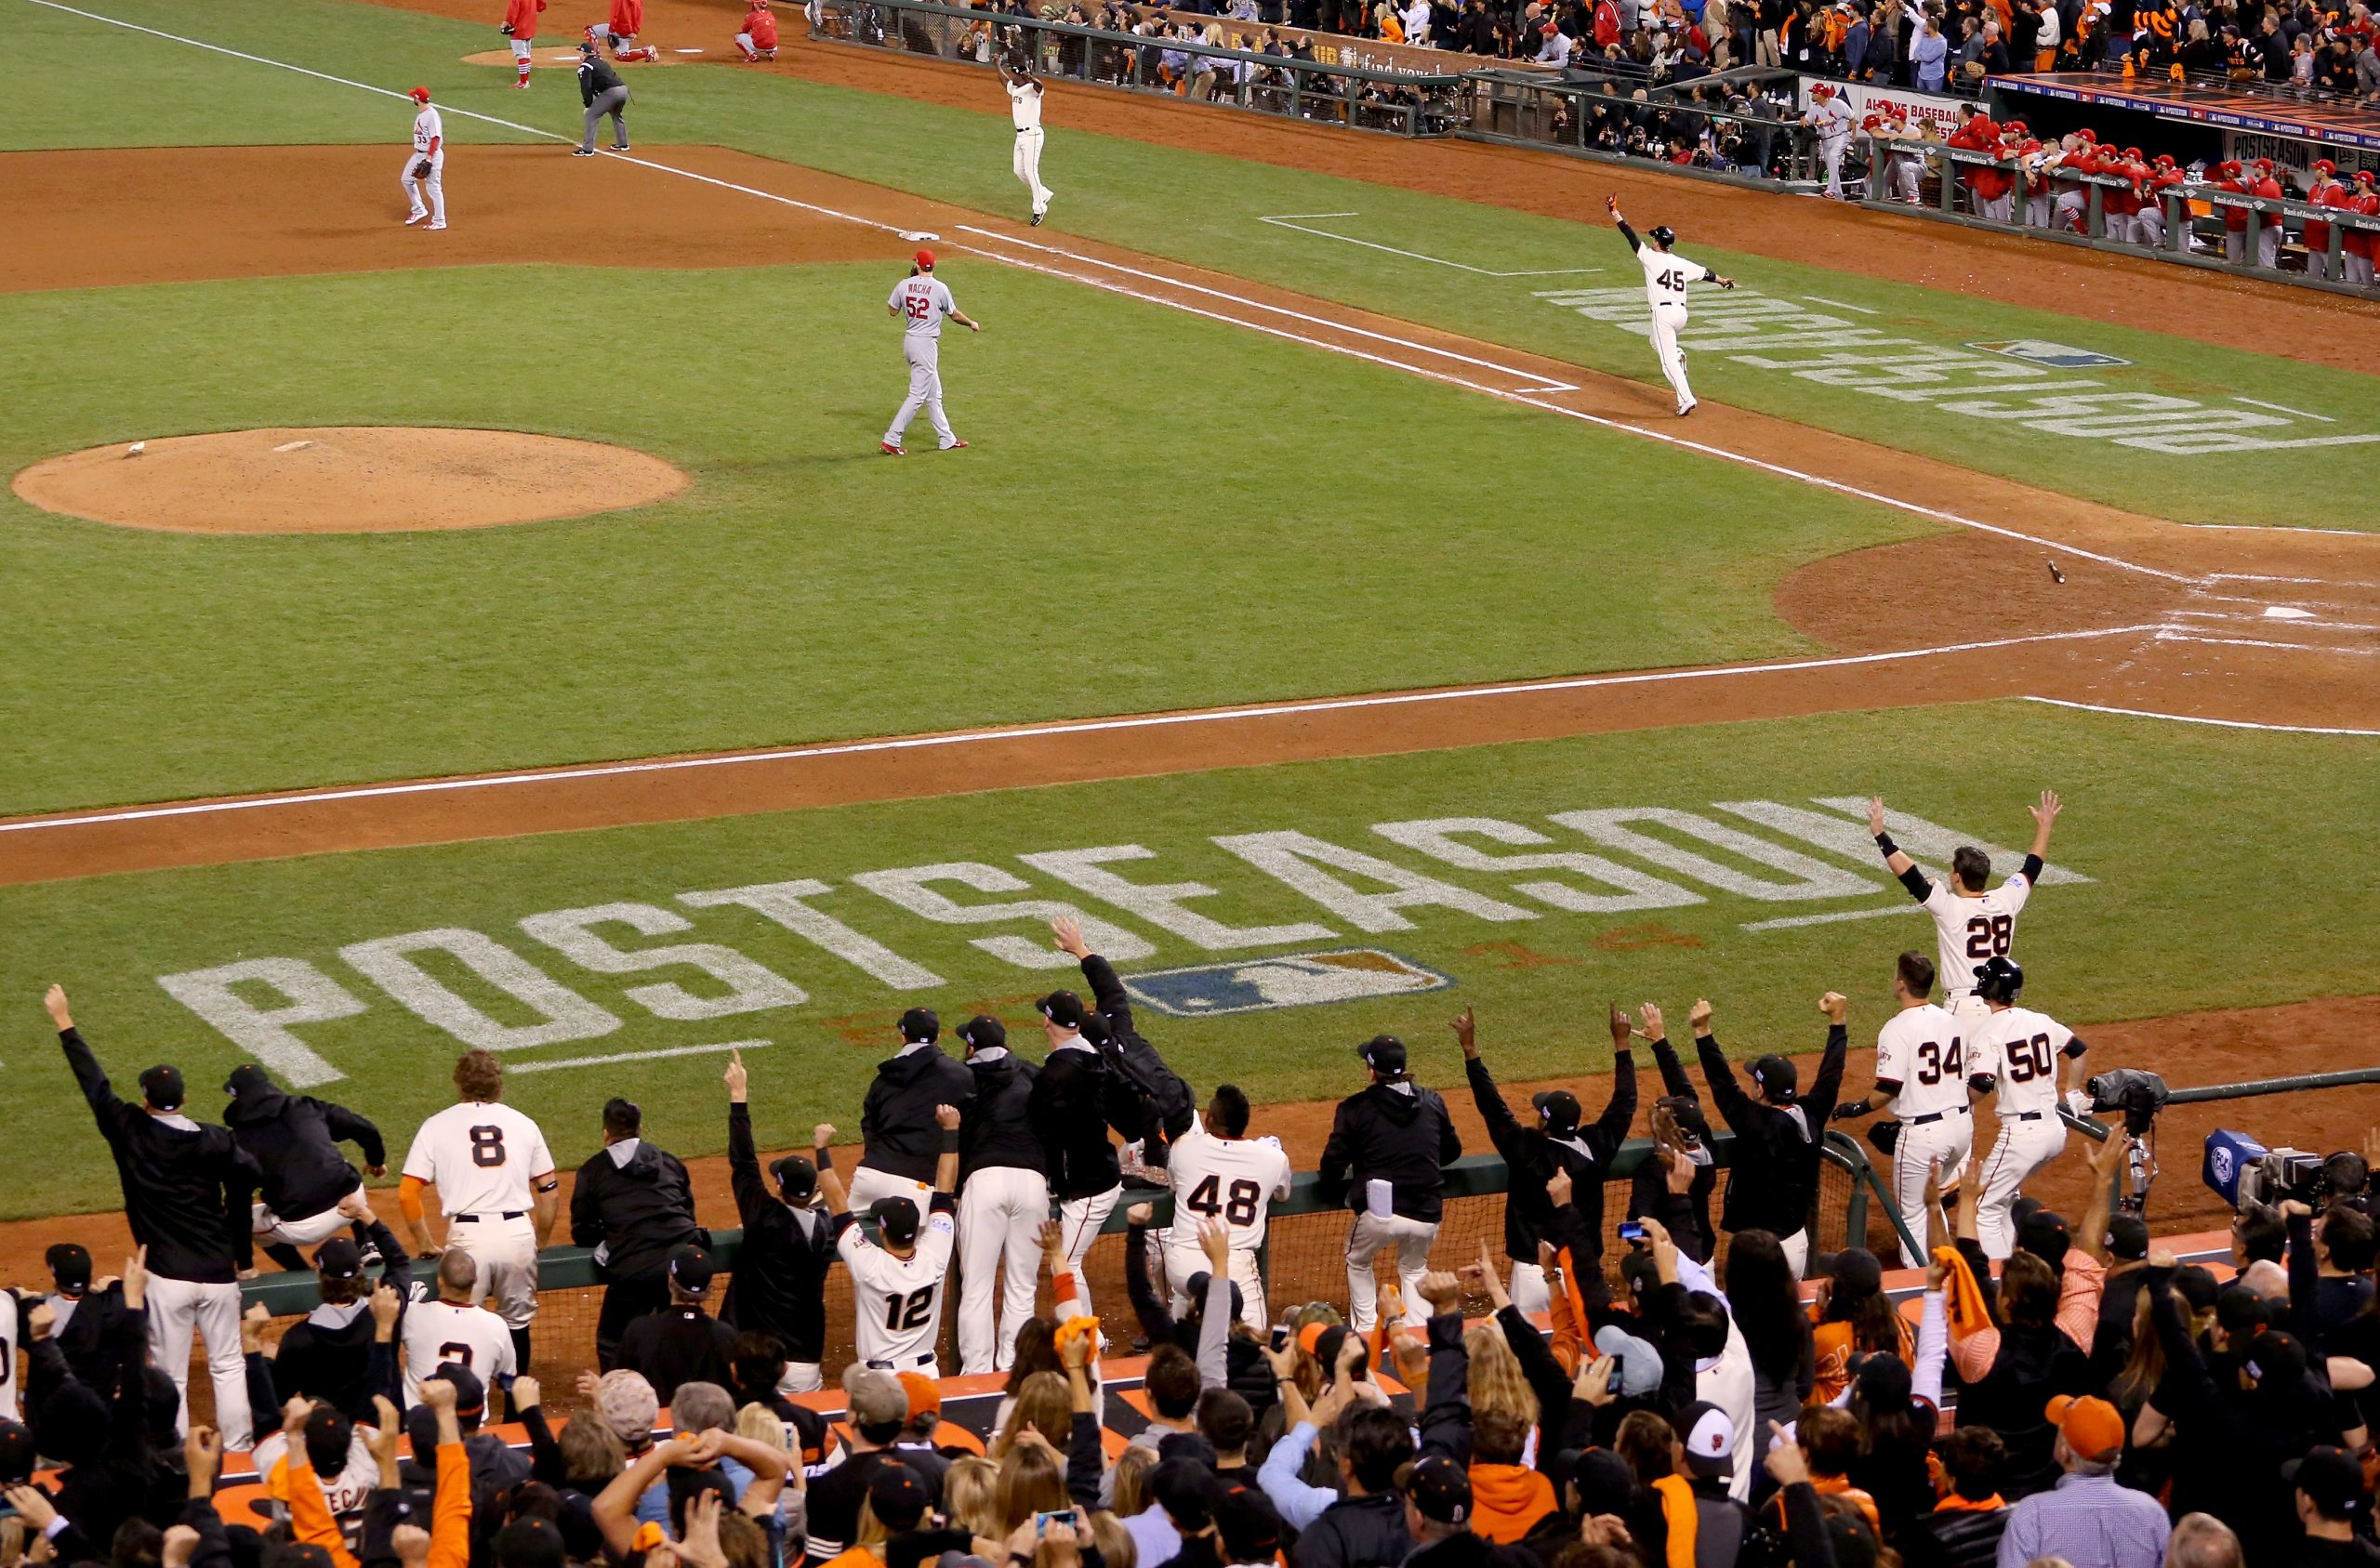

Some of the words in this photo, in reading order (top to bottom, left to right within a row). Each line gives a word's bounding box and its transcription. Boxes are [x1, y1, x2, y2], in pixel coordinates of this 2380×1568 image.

[417, 136, 428, 144] 33
[2233, 135, 2309, 173] POSTSEASON
[1656, 269, 1685, 292] 45
[906, 296, 930, 320] 52
[158, 797, 2096, 1088] POSTSEASON
[1966, 916, 2013, 957] 28
[1918, 1035, 1964, 1086] 34
[2005, 1032, 2053, 1084] 50
[468, 1124, 507, 1168] 8
[1186, 1174, 1262, 1227] 48
[883, 1292, 932, 1331] 12
